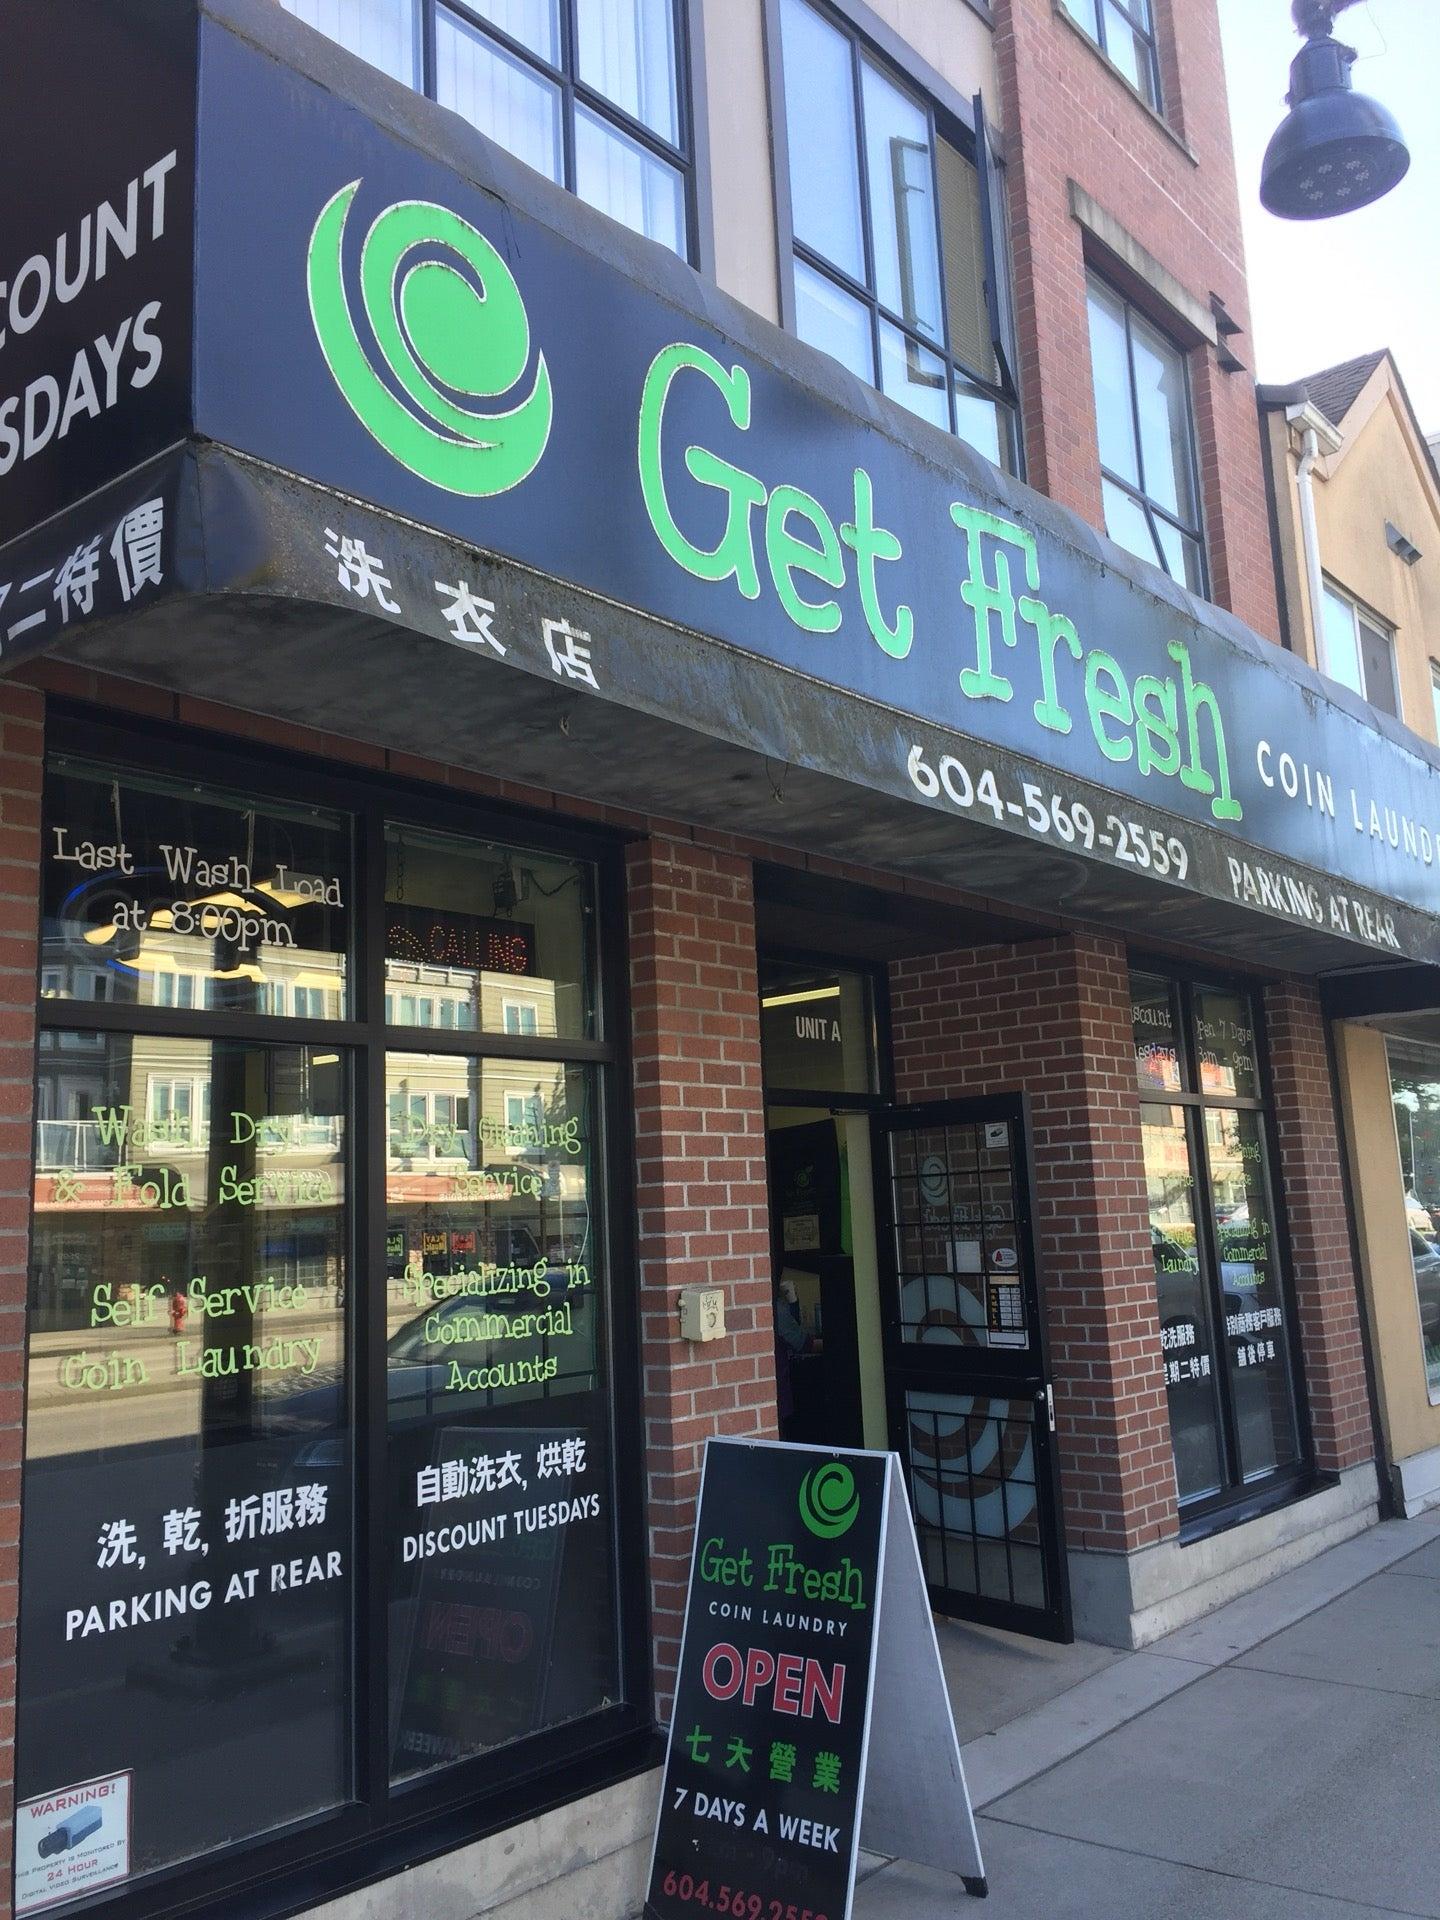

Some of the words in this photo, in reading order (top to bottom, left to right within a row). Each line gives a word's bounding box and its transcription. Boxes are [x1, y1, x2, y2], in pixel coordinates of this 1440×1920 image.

[0, 148, 177, 349] OUNT
[0, 497, 164, 654] 二特價
[637, 341, 914, 659] Get
[949, 501, 1242, 821] Fresh
[323, 527, 599, 689] 洗衣店
[907, 744, 1188, 880] 604-569-2559
[1256, 740, 1335, 818] COIN
[1350, 788, 1440, 868] LAUND
[53, 827, 134, 875] Last
[159, 845, 255, 894] Wash
[276, 864, 344, 908] Load
[112, 900, 147, 931] at
[171, 900, 298, 952] 8:00pm
[1227, 856, 1324, 924] PARKING
[1329, 895, 1350, 933] AT
[1352, 900, 1401, 949] REAR
[795, 1015, 827, 1041] UNIT
[830, 1019, 842, 1043] A
[1132, 1006, 1172, 1029] scount
[1219, 1018, 1226, 1040] 7
[1230, 1022, 1253, 1047] Days
[478, 1115, 582, 1154] Cleaning
[55, 1168, 86, 1203] &
[112, 1164, 194, 1209] Fold
[218, 1165, 336, 1206] Service
[453, 1162, 543, 1198] Service
[91, 1282, 165, 1327] Self
[187, 1275, 309, 1318] Service
[402, 1257, 550, 1307] Specializing
[566, 1258, 591, 1289] in
[424, 1301, 574, 1345] Commercial
[62, 1350, 150, 1391] Coin
[176, 1337, 324, 1378] Laundry
[444, 1354, 558, 1392] Accounts
[402, 1514, 508, 1563] DISCOUNT
[513, 1493, 600, 1536] TUESDAYS
[66, 1581, 213, 1642] PARKING
[224, 1568, 260, 1605] AT
[270, 1551, 343, 1594] REAR
[700, 1537, 754, 1587] Get
[763, 1543, 867, 1610] Fresh
[708, 1601, 752, 1621] COIN
[762, 1609, 848, 1637] LAUNDRY
[702, 1642, 847, 1724] OPEN
[30, 1783, 116, 1818] WARNING!
[673, 1787, 688, 1810] 7
[693, 1792, 746, 1827] DAYS
[752, 1808, 769, 1835] A
[779, 1813, 841, 1854] WEEK
[47, 1869, 63, 1882] 24
